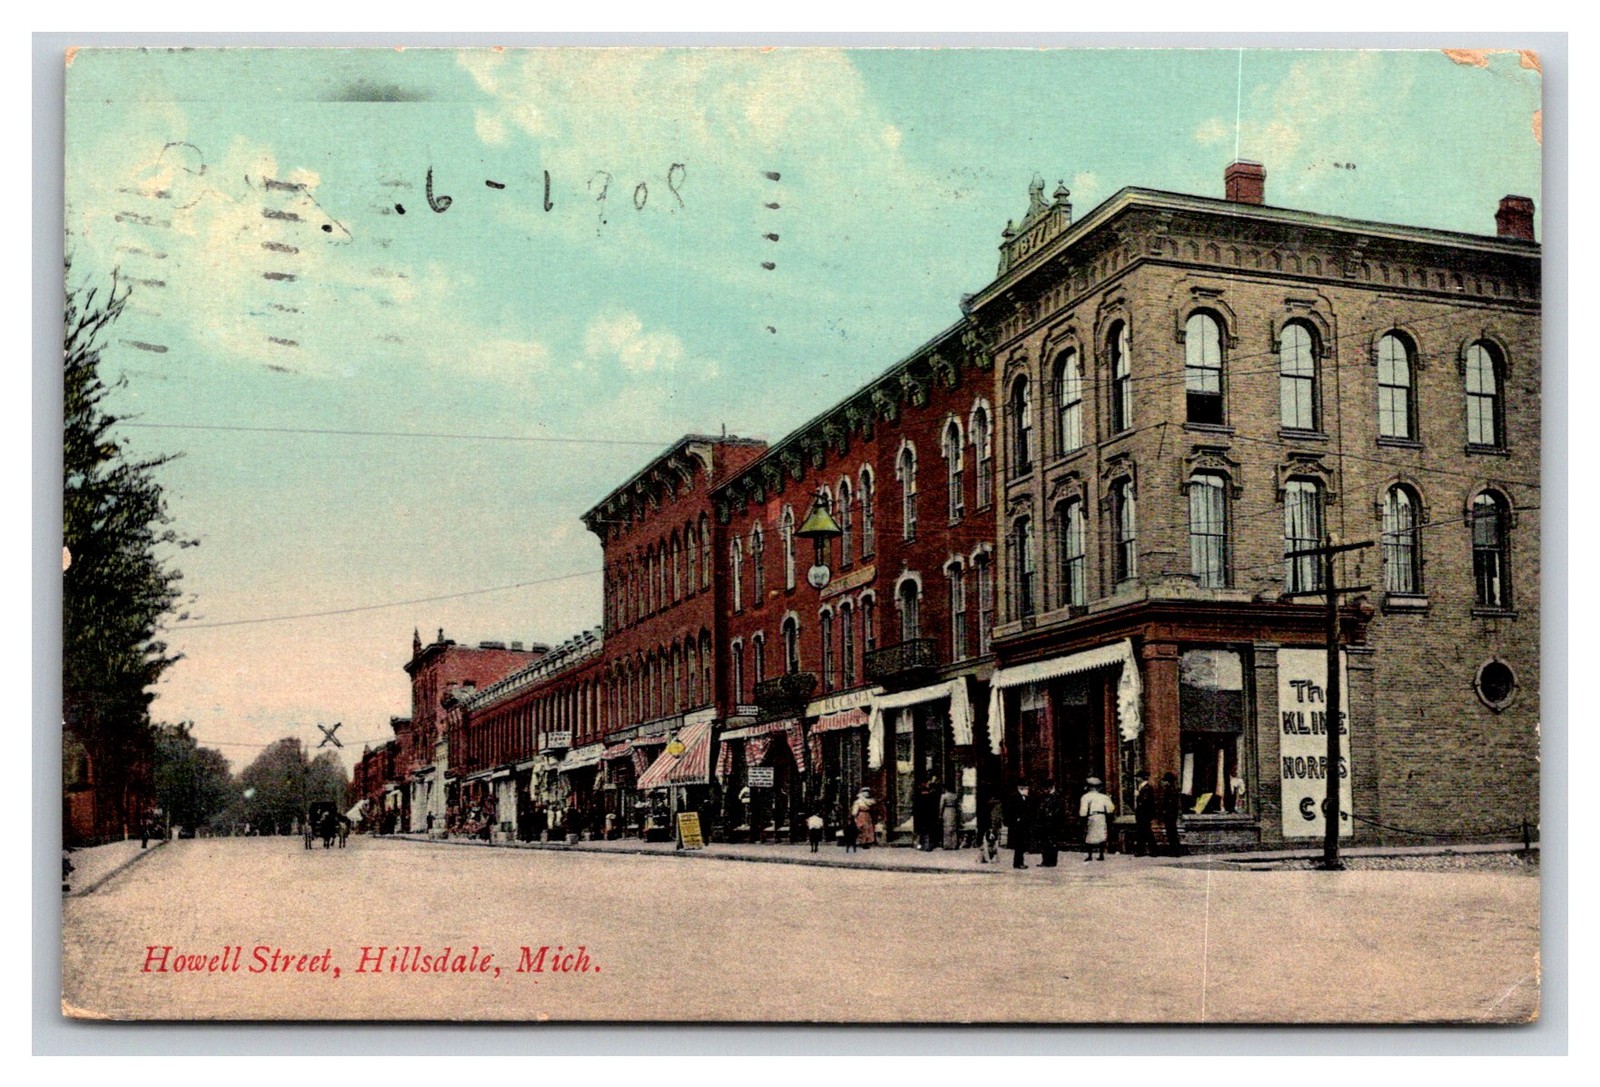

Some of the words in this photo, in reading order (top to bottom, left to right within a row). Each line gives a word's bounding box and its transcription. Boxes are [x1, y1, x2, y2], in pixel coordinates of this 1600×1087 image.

[1289, 680, 1326, 703] Th
[1282, 711, 1347, 735] KLINE
[1283, 756, 1348, 779] NORRS
